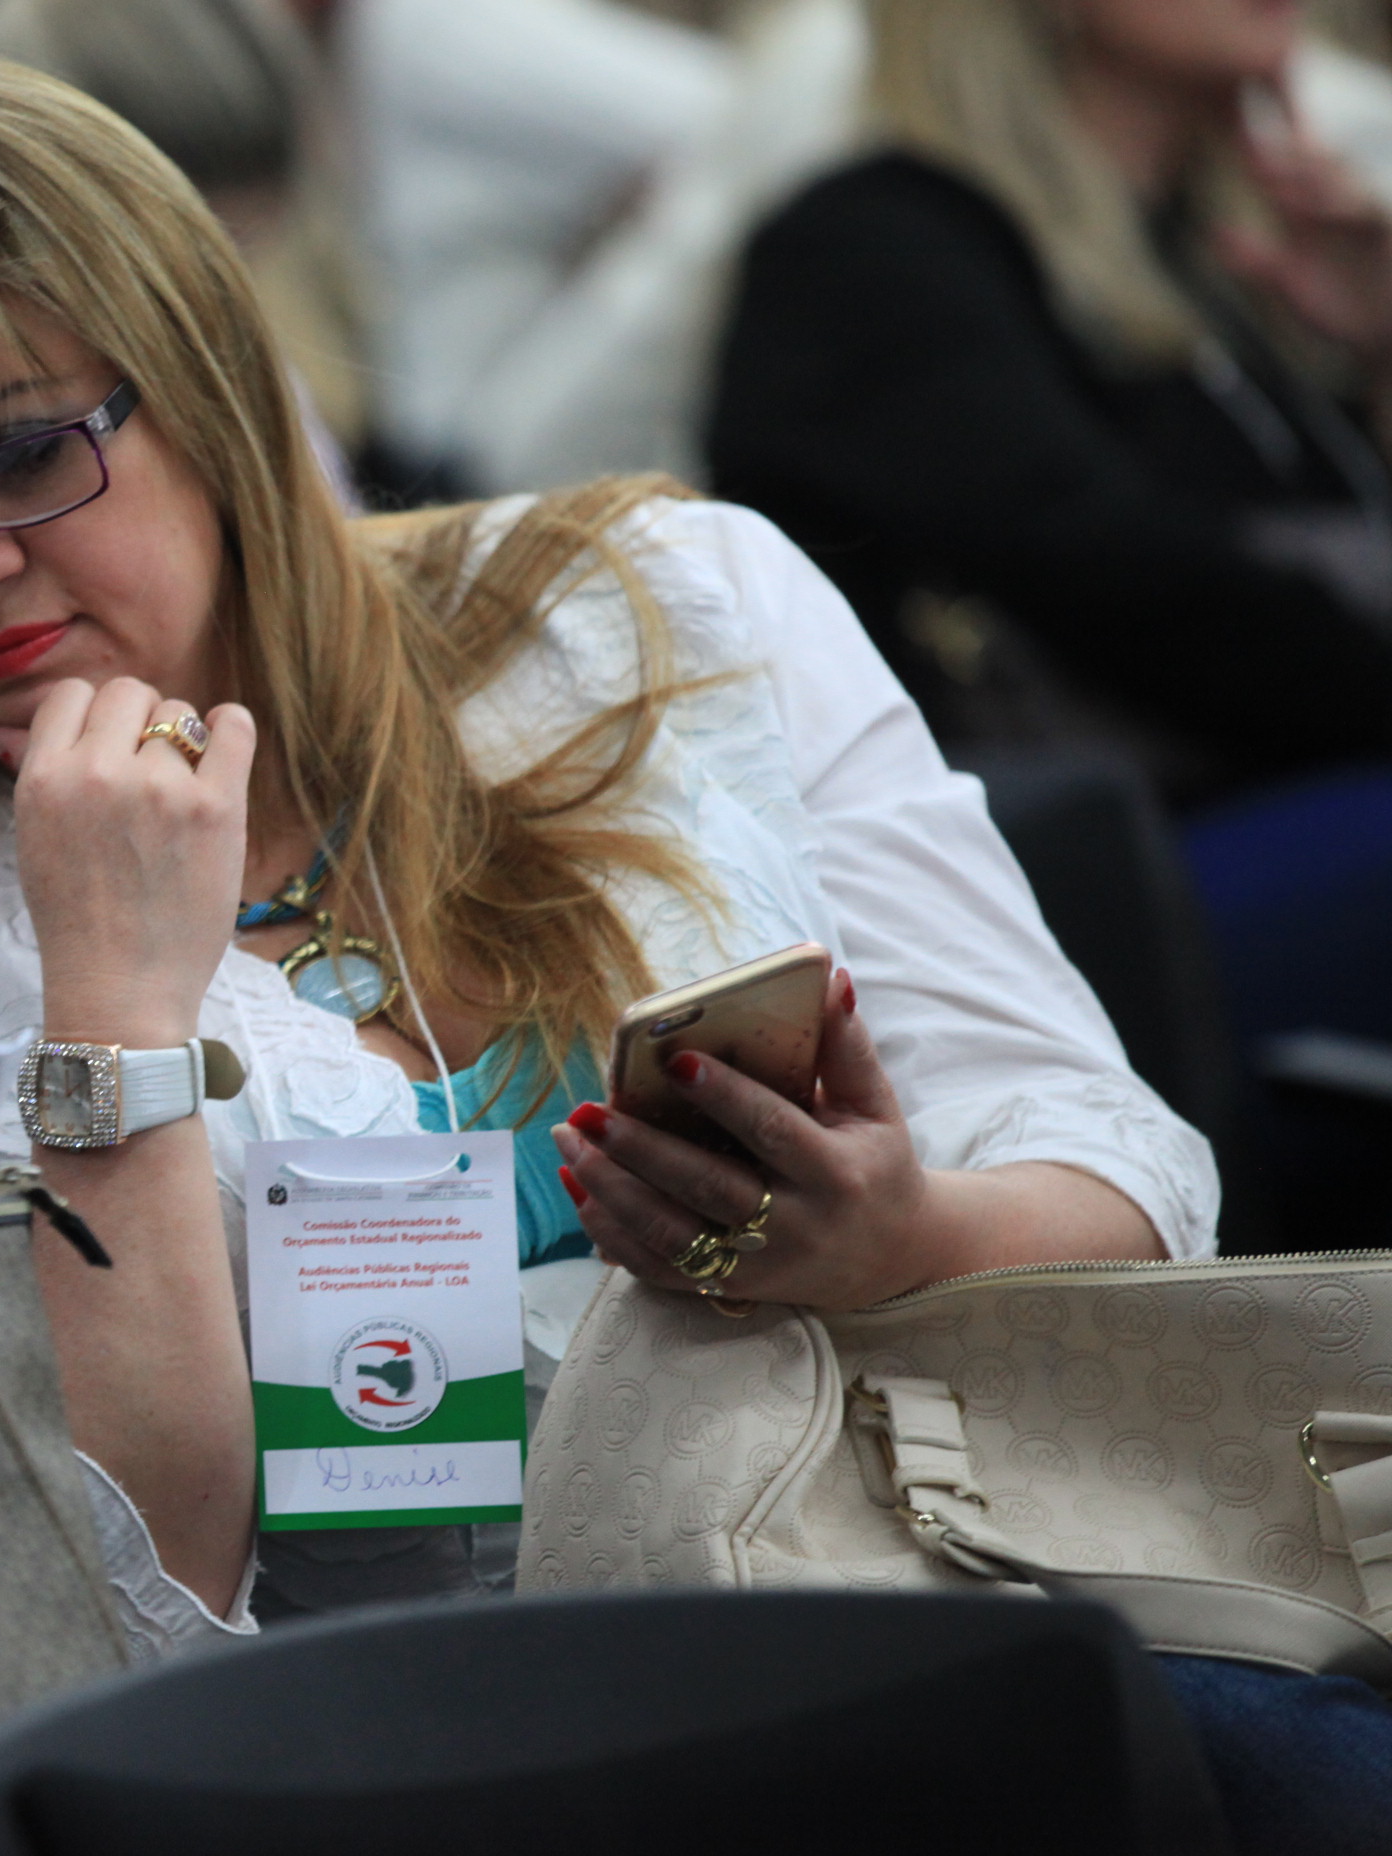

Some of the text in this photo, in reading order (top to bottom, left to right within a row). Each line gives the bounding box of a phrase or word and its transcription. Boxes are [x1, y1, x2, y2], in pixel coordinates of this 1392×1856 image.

[303, 1216, 461, 1231] Comissão Coordenadora do
[283, 1230, 483, 1248] Orçamento Estadual Regionalizado
[364, 1263, 411, 1274] Públicas
[414, 1260, 470, 1274] Regionais
[300, 1281, 316, 1292] Lei
[319, 1279, 397, 1292] Orçamentária
[400, 1277, 434, 1288] Anual
[445, 1276, 470, 1286] LOA
[316, 1447, 460, 1492] Denise
